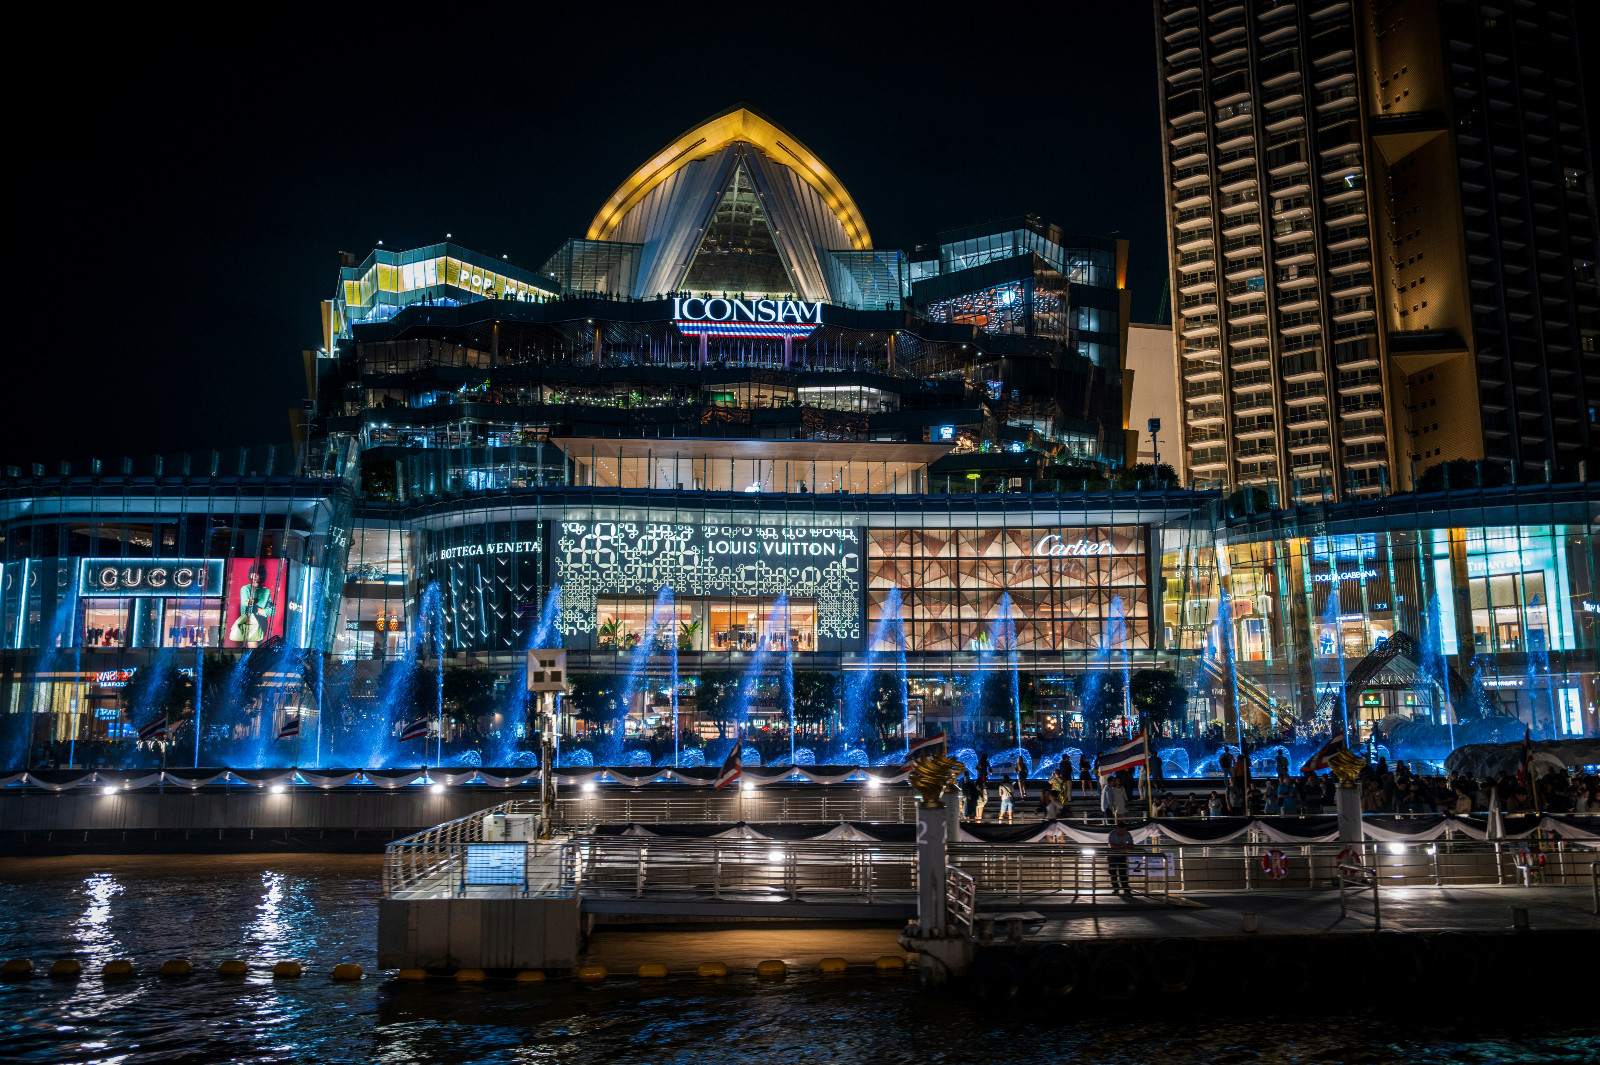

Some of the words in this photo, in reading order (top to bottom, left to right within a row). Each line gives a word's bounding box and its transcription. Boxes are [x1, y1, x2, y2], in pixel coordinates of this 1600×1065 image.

[460, 269, 492, 291] POP
[673, 298, 823, 323] ICONSIAM
[441, 544, 484, 559] BOTTEGA
[487, 541, 541, 554] VENETA
[708, 541, 757, 554] LOUIS
[763, 542, 836, 556] VUITTON
[1037, 535, 1112, 556] Cartier
[1467, 559, 1505, 571] TIFFANY
[101, 568, 205, 587] GUCCI
[1133, 861, 1142, 872] 2
